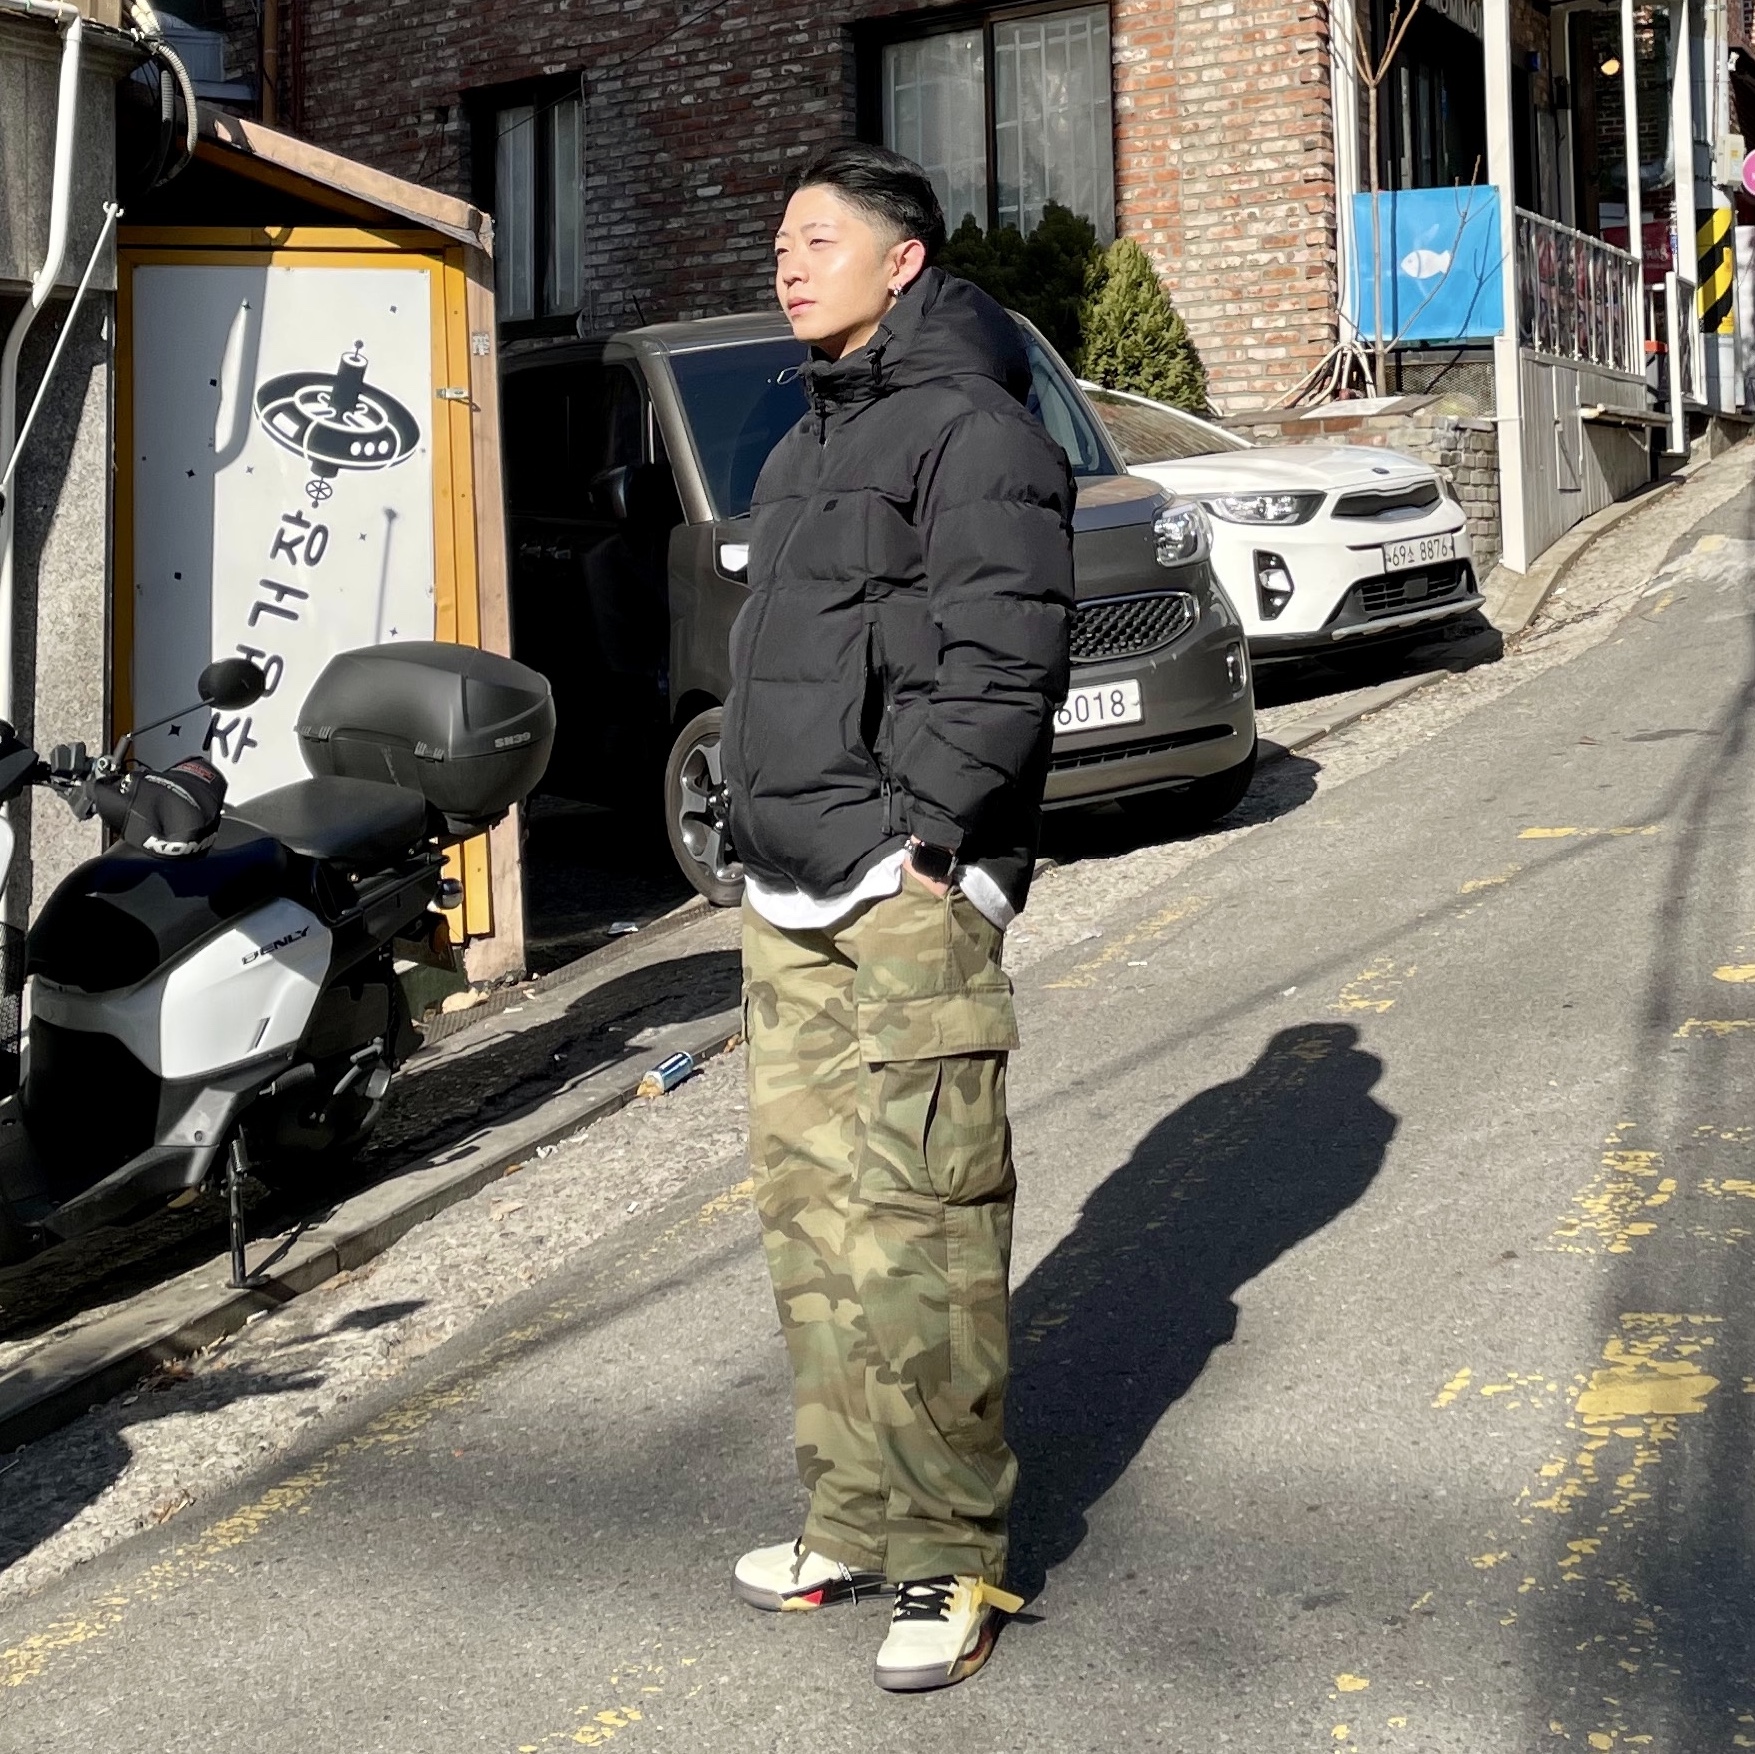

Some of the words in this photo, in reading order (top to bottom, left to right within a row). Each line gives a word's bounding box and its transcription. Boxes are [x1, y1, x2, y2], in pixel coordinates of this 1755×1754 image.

[1392, 545, 1415, 567] 69소
[1420, 538, 1448, 561] 8876
[241, 926, 310, 965] DENLY
